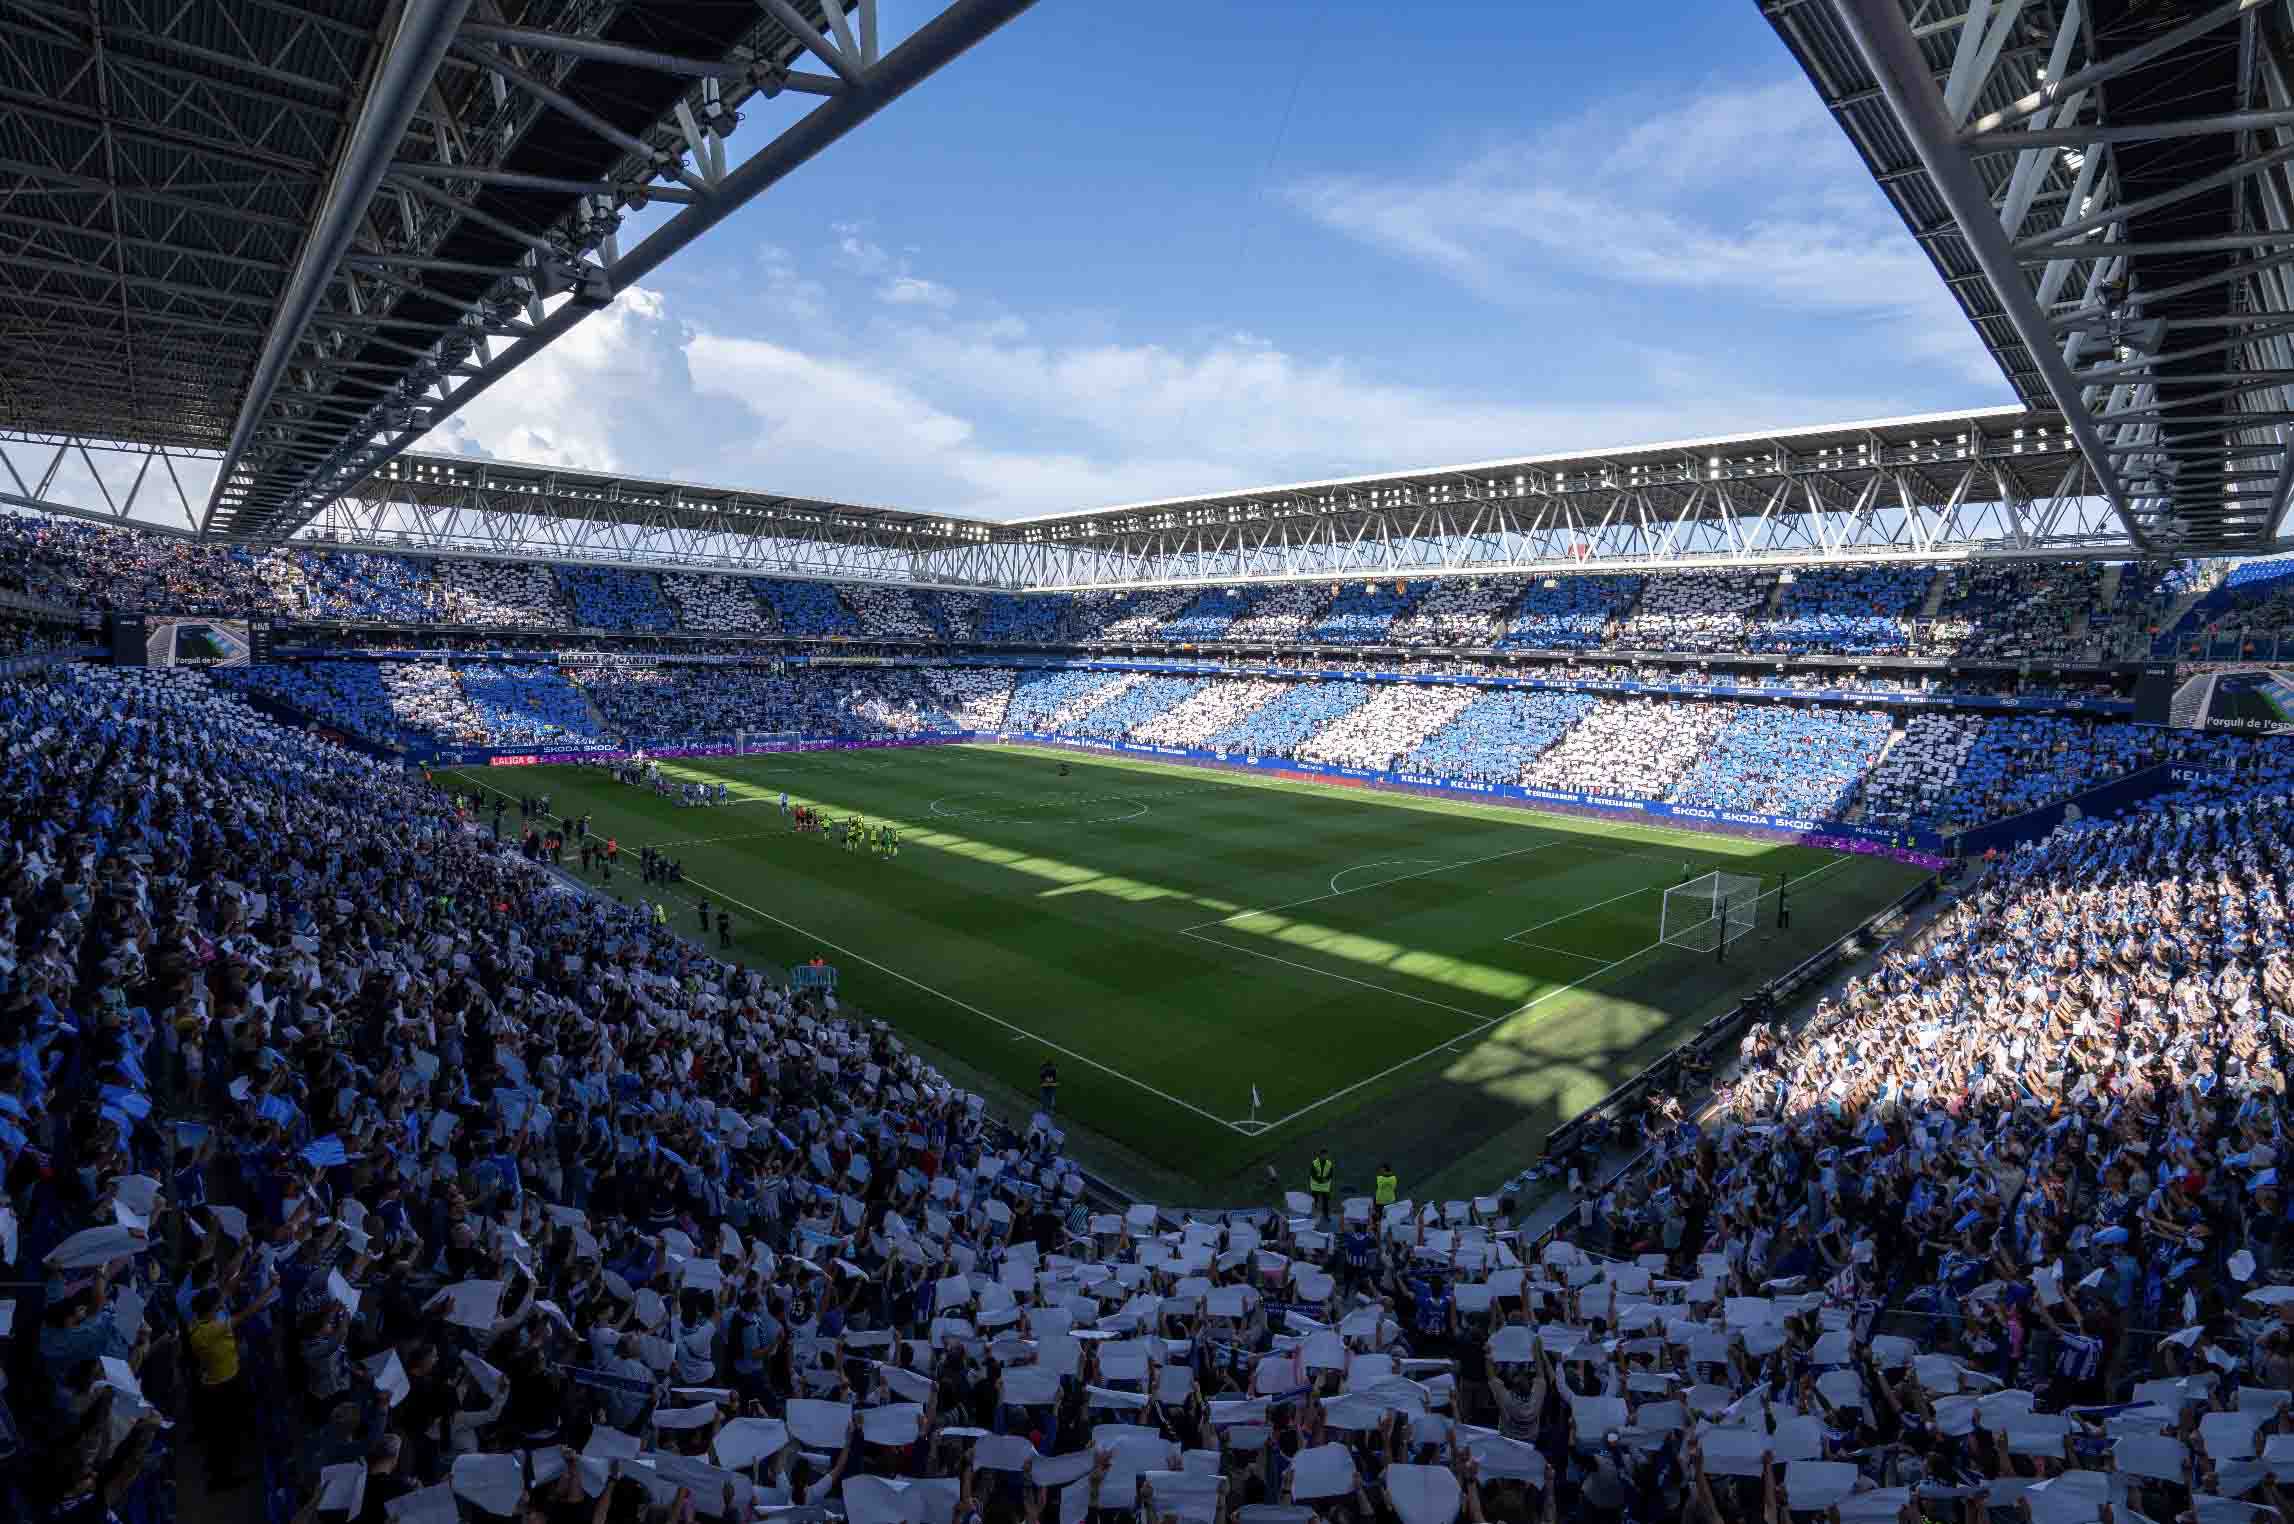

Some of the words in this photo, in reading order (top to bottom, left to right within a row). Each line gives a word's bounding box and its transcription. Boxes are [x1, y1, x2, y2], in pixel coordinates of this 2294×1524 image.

[618, 656, 657, 665] CANITO
[2247, 717, 2261, 728] de
[492, 756, 524, 766] LALIGA
[1402, 774, 1433, 785] KELME
[1451, 780, 1485, 791] KELME
[1855, 827, 1889, 836] KELME
